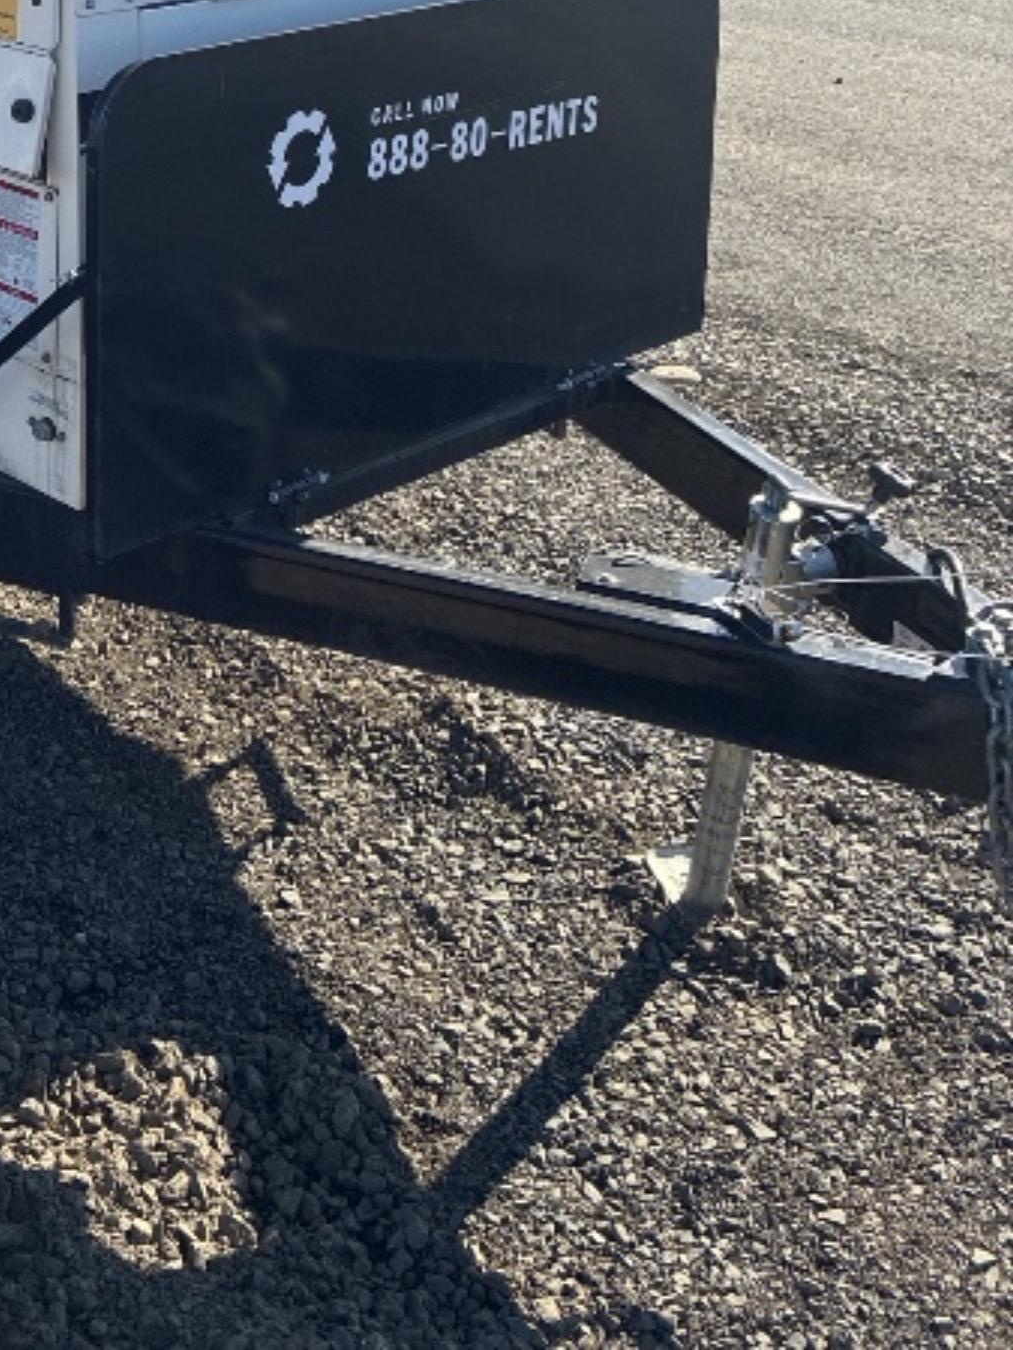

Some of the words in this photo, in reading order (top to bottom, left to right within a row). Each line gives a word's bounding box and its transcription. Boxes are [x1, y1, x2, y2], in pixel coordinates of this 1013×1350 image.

[367, 95, 599, 181] 888-80-RENTS
[371, 101, 414, 127] CALL
[421, 92, 459, 116] NOW
